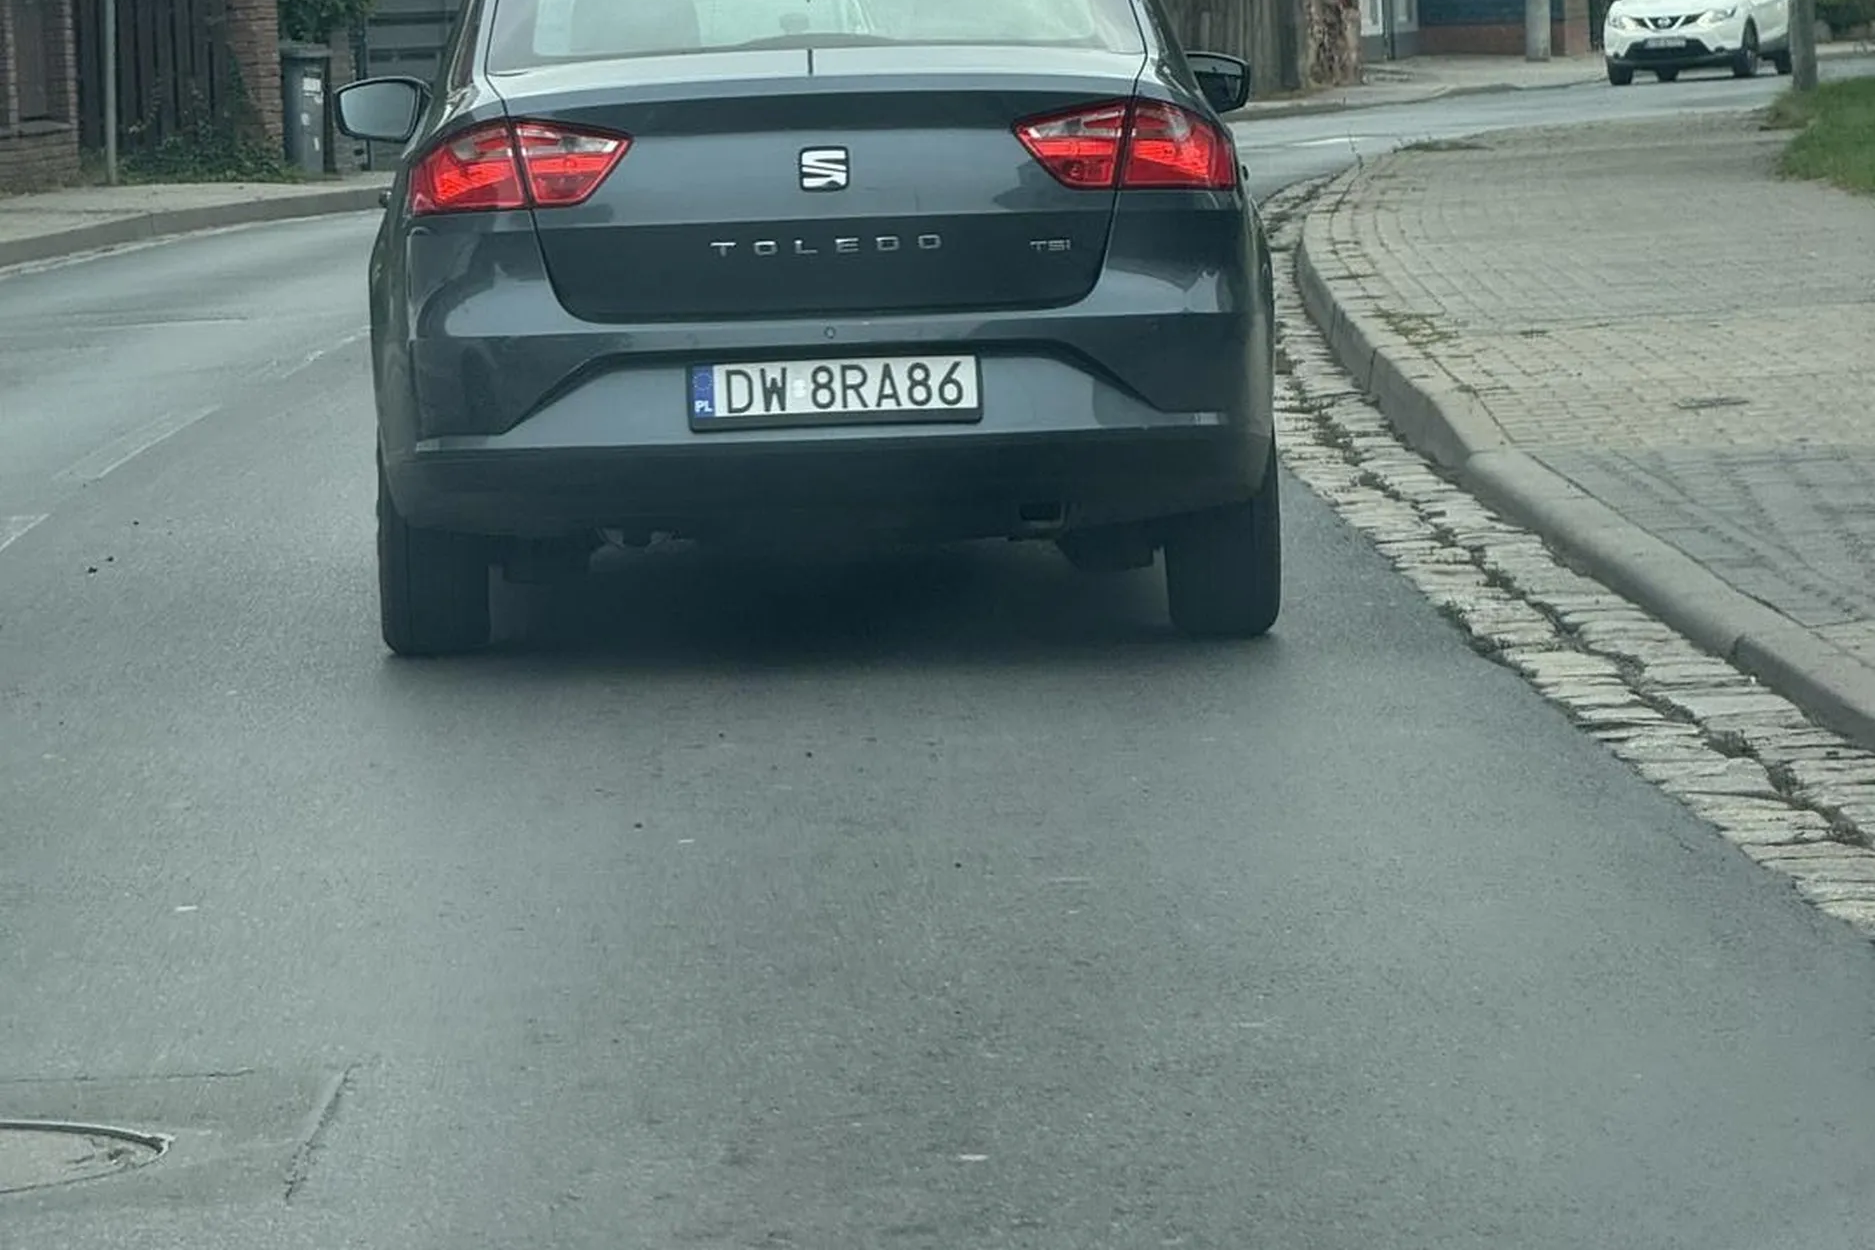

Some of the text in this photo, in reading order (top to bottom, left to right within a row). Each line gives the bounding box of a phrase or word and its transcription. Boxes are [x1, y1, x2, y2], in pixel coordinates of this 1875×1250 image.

[710, 234, 942, 257] TOLEDO
[726, 361, 962, 414] DW 8RA86
[695, 400, 712, 413] PL
